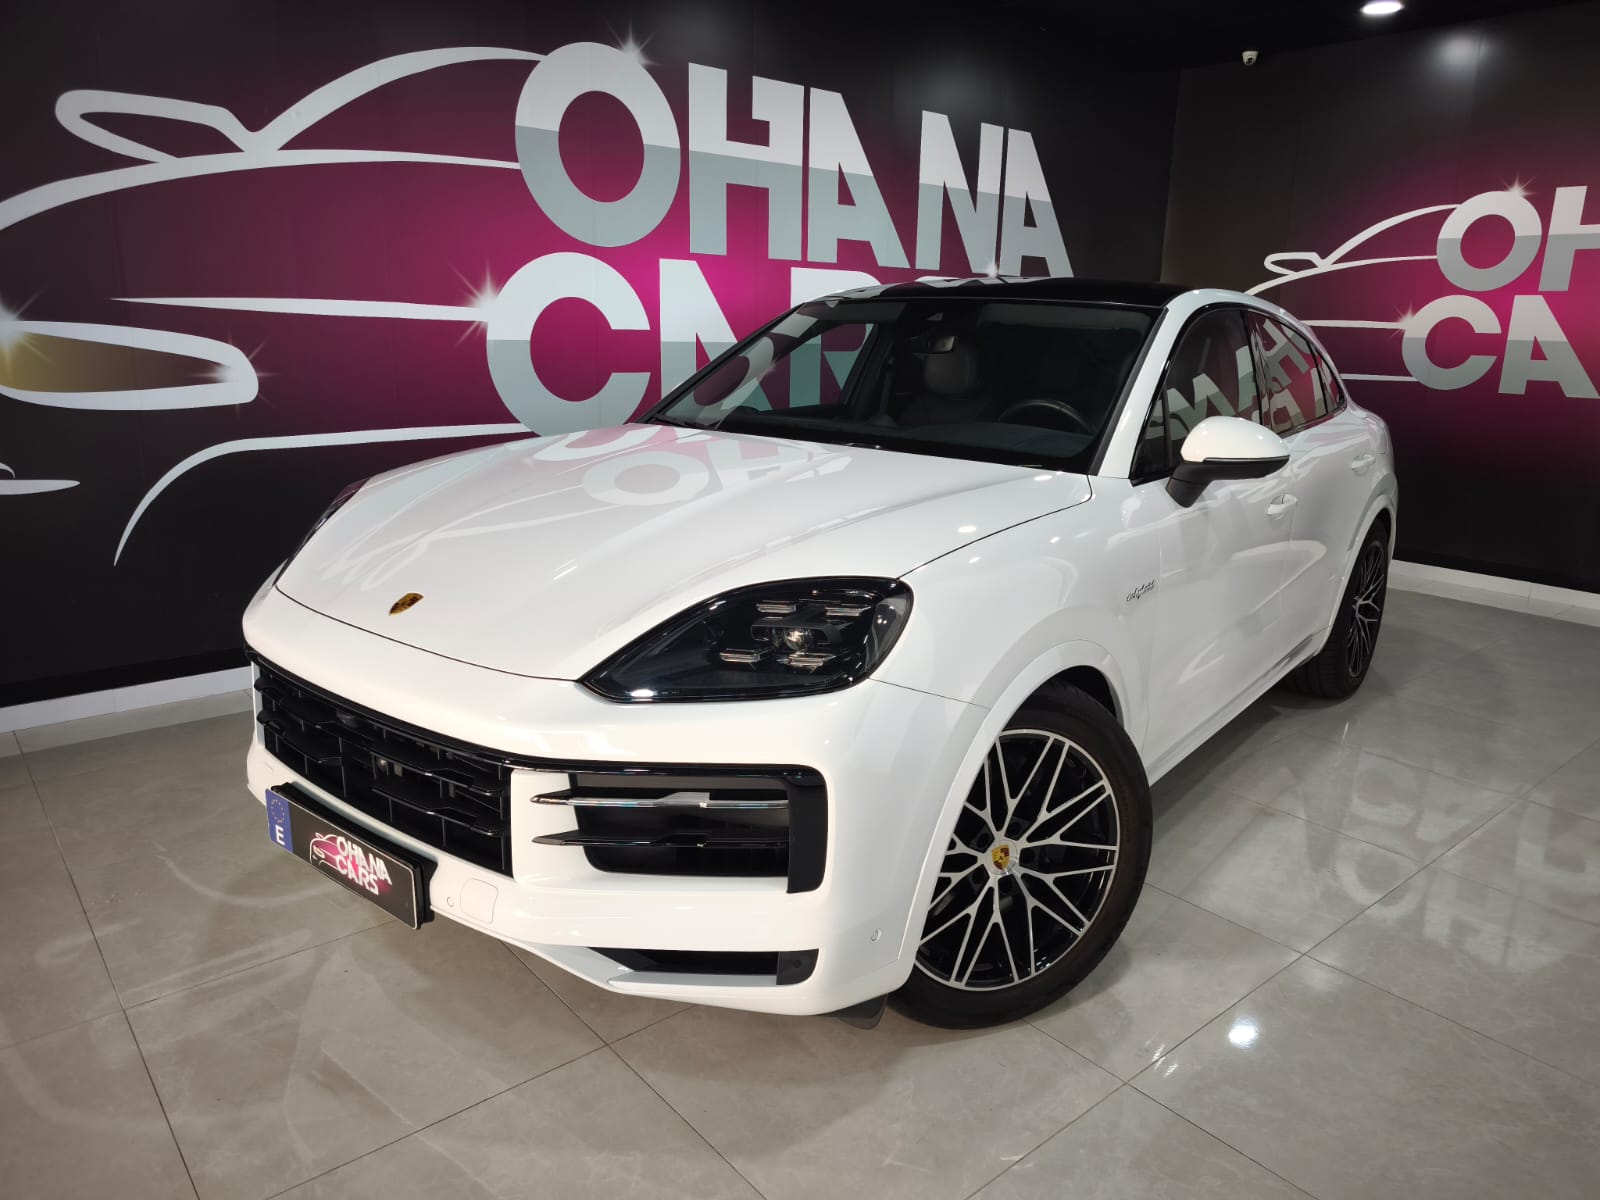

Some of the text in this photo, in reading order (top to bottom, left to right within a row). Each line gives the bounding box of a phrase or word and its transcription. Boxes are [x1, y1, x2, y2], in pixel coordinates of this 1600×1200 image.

[515, 42, 1074, 278] OHANA
[486, 252, 958, 437] CAR
[275, 825, 286, 846] E
[336, 836, 393, 886] OHANA
[336, 855, 379, 896] CARS
